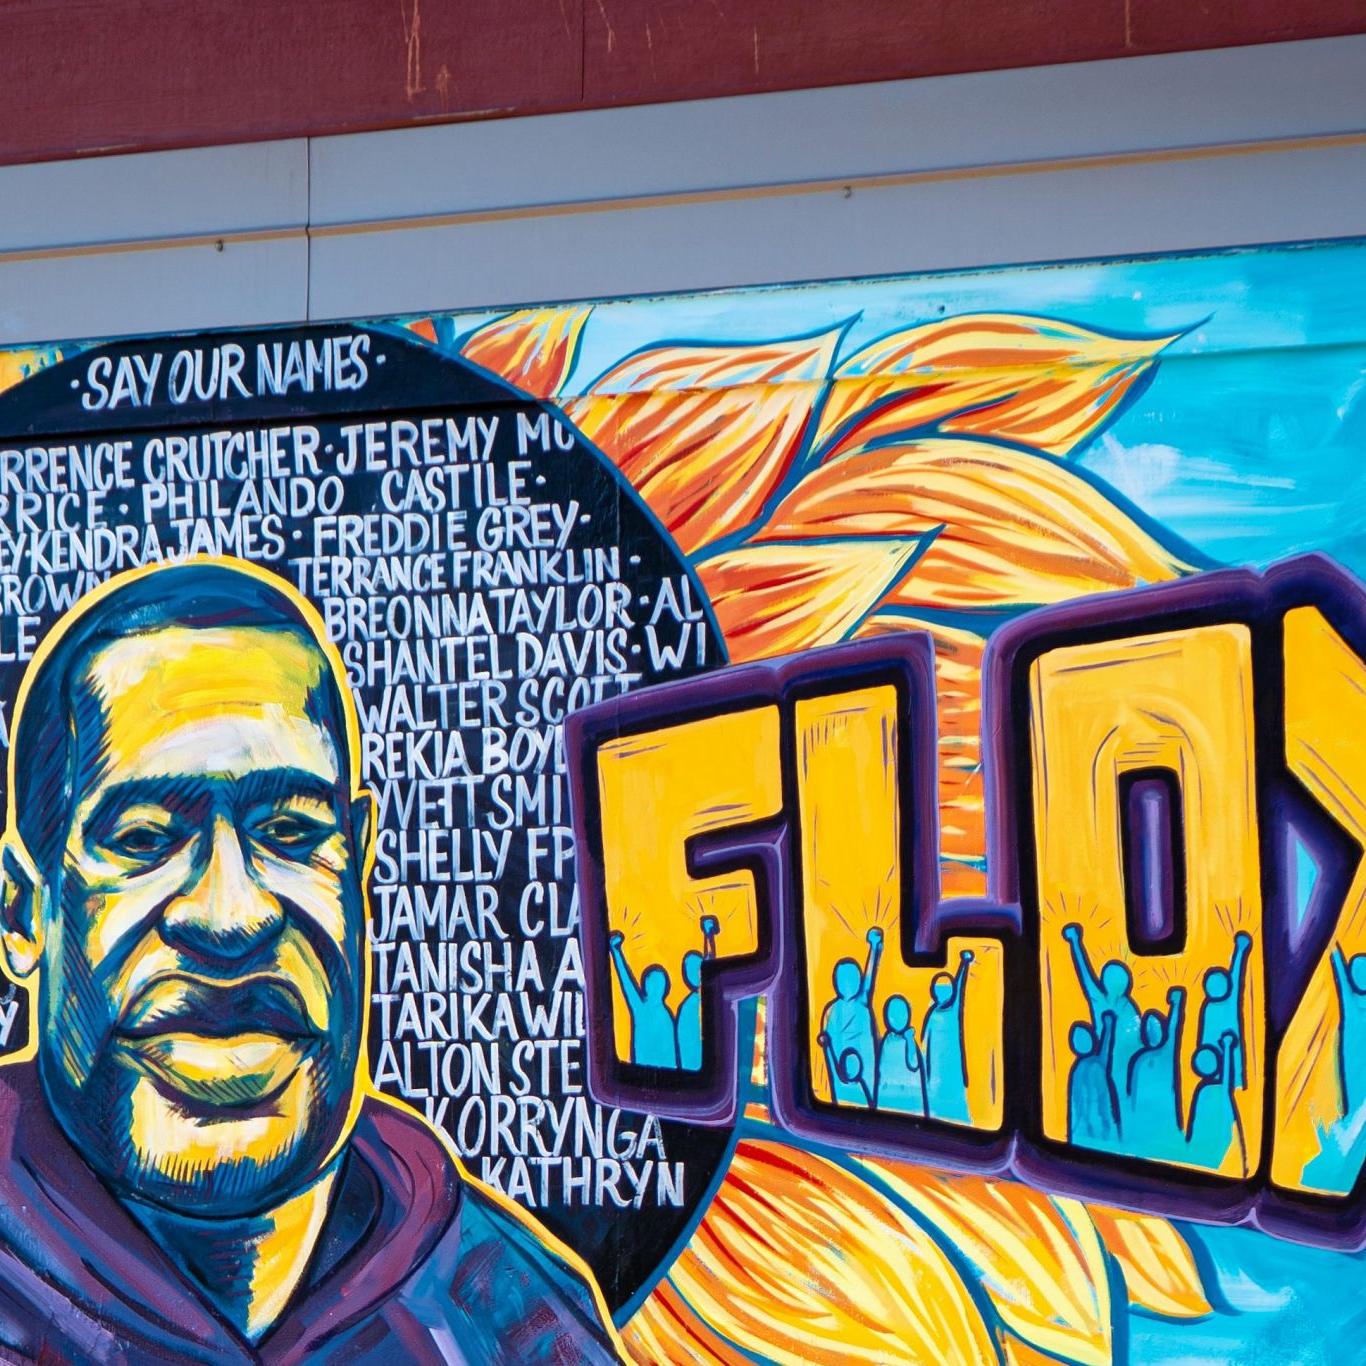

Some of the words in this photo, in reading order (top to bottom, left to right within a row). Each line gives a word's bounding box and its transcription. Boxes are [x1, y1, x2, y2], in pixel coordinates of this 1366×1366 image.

[82, 351, 164, 410] SAY
[168, 345, 252, 402] OUR
[257, 334, 370, 396] NAMES
[143, 426, 329, 485] CRUTCHER
[337, 416, 498, 475] JEREMY
[16, 491, 107, 536] RICE
[141, 476, 344, 523] PHILANDO
[381, 461, 532, 513] CASTILE
[166, 514, 285, 563] JAMES
[314, 511, 466, 557] FREDDIE
[477, 501, 580, 551] GREY
[294, 553, 446, 598] TERRANCE
[453, 546, 620, 589] FRANKLIN
[324, 594, 493, 642] BREONNA
[486, 582, 635, 635] TAYLOR
[649, 575, 704, 626] AL
[344, 634, 514, 689] SHANTEL
[518, 629, 628, 680] DAVIS
[645, 621, 707, 671] WI
[353, 685, 508, 734] WALTER
[364, 731, 471, 780] REKIA
[374, 828, 513, 883] SHELLY
[368, 885, 508, 942] JAMAR
[372, 941, 546, 995] TANISHA
[372, 993, 520, 1041] TARIKA
[374, 1041, 501, 1097] ALTON
[425, 1095, 666, 1160] KORRYNGA
[481, 1156, 685, 1210] KATHRYN
